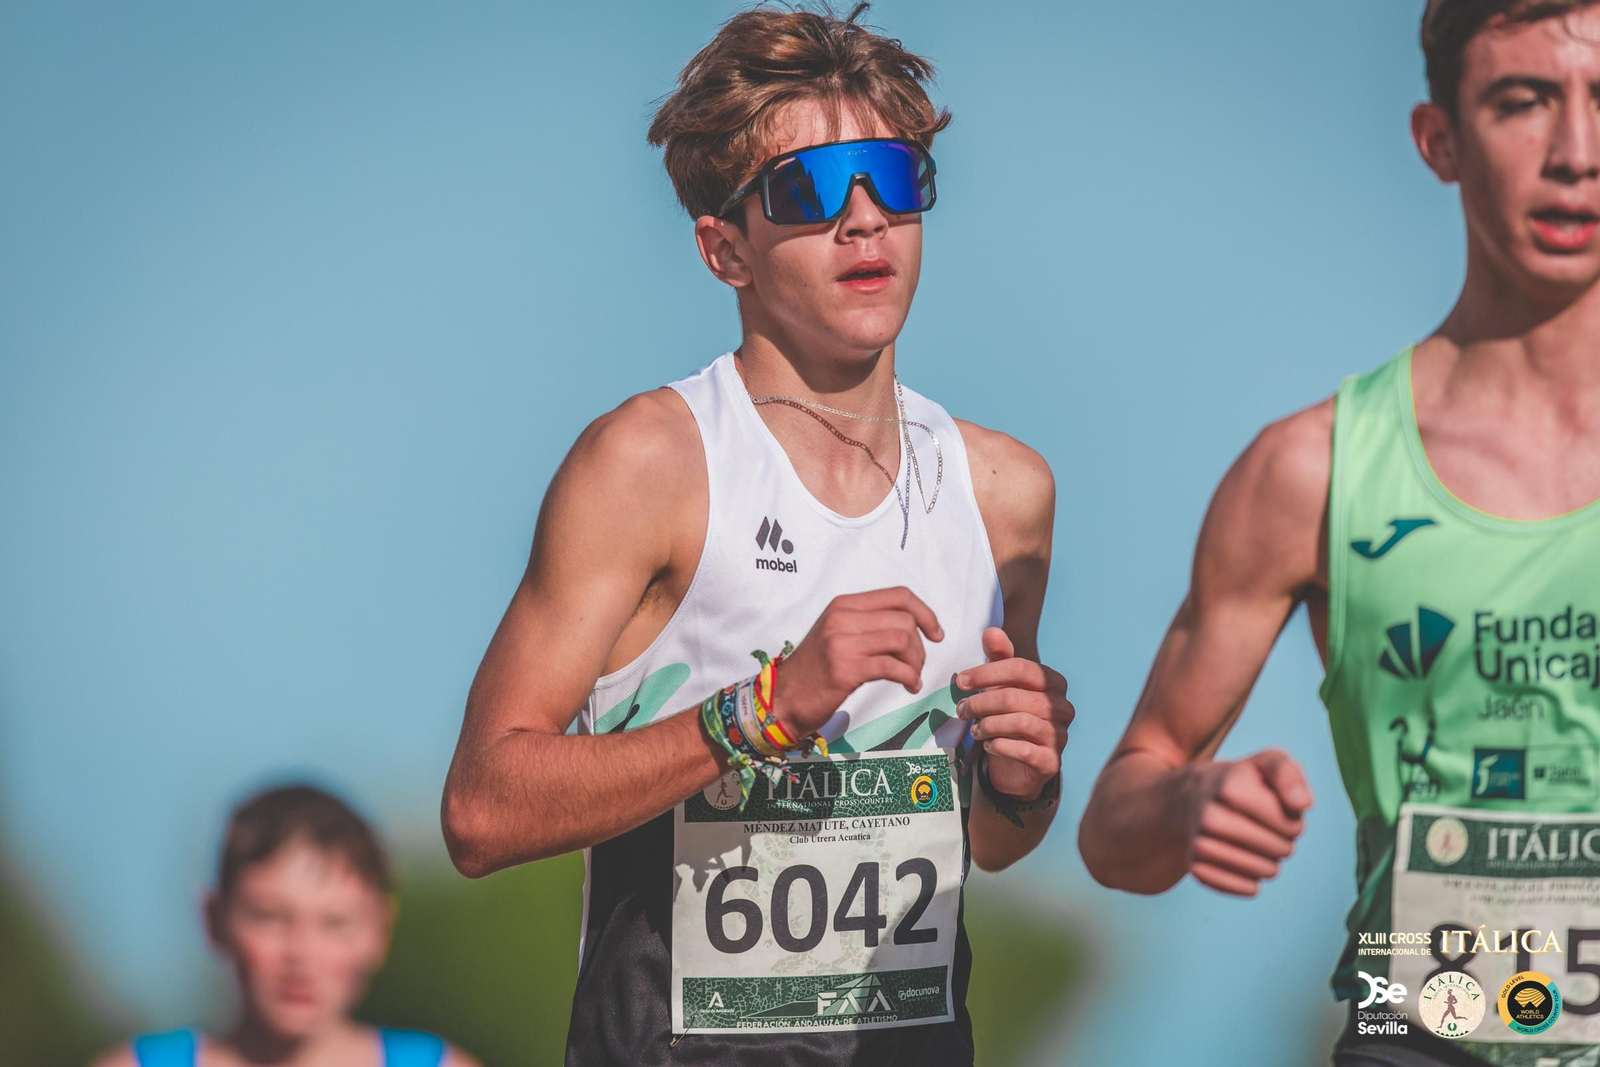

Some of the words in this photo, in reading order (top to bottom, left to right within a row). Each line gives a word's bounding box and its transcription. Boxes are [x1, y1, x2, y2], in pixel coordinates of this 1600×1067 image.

[756, 558, 797, 573] mobel
[766, 765, 894, 800] ITÁLICA
[767, 800, 832, 810] INTERNATIONAL
[834, 799, 858, 807] CROSS
[859, 797, 894, 805] COUNTRY
[743, 821, 796, 833] MÉNDEZ
[798, 819, 849, 832] MATUTE,
[851, 816, 911, 829] CAYETANO
[789, 835, 809, 844] Club
[811, 834, 836, 843] Utrera
[838, 832, 871, 842] Acuatica
[705, 857, 938, 954] 6042
[906, 987, 940, 998] docunova
[736, 1018, 791, 1029] FEDERACIÓN
[794, 1018, 840, 1028] ANDALUZA
[843, 1017, 853, 1025] DE
[857, 1014, 898, 1025] ATLETISMO
